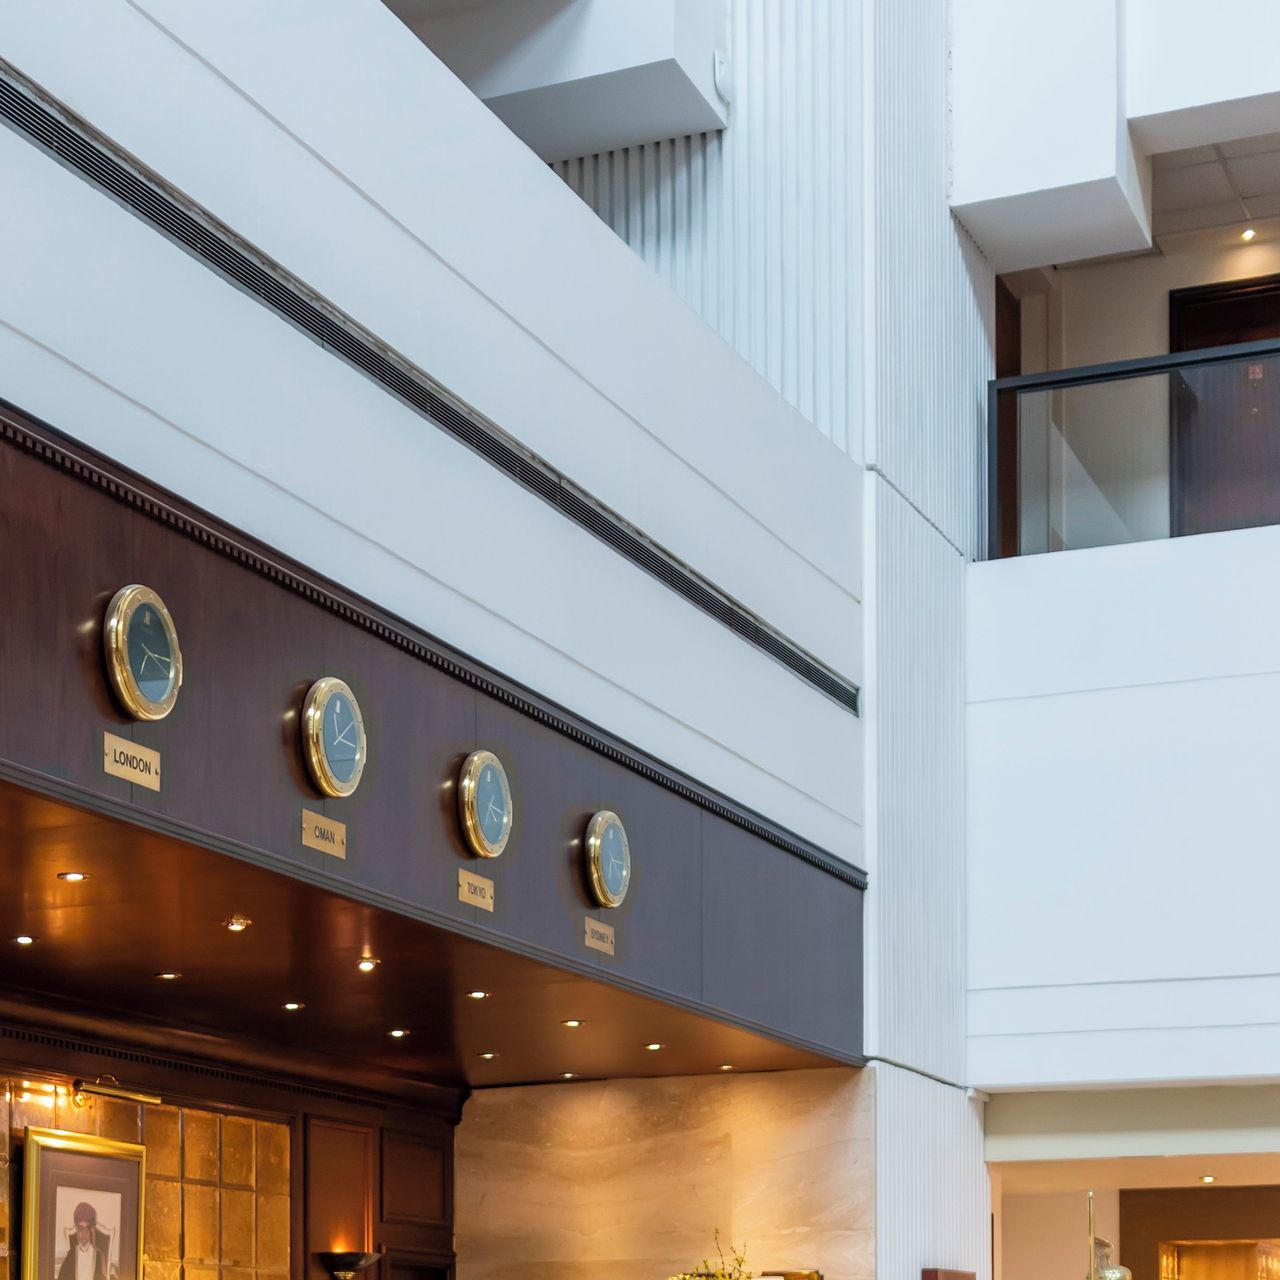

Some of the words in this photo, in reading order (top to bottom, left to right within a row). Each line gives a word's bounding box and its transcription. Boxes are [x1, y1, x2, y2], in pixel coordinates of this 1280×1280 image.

[114, 748, 151, 775] LONDON
[314, 825, 335, 844] OMAN
[467, 881, 486, 899] TOKYO
